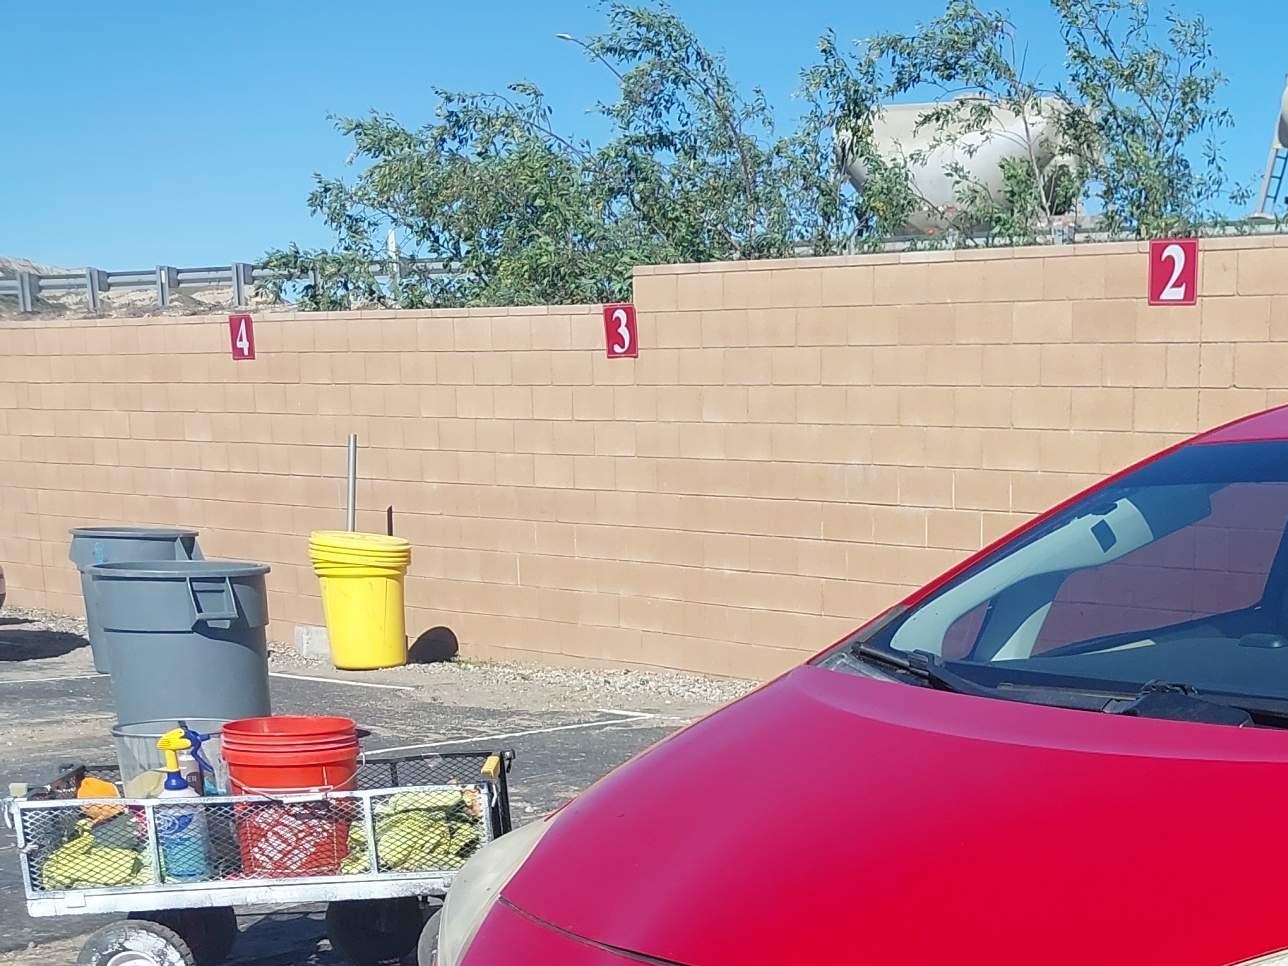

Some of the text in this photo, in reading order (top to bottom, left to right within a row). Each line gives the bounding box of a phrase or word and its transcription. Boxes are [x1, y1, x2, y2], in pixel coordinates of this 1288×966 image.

[1159, 243, 1186, 300] 2
[236, 318, 250, 356] 4
[612, 308, 630, 353] 3
